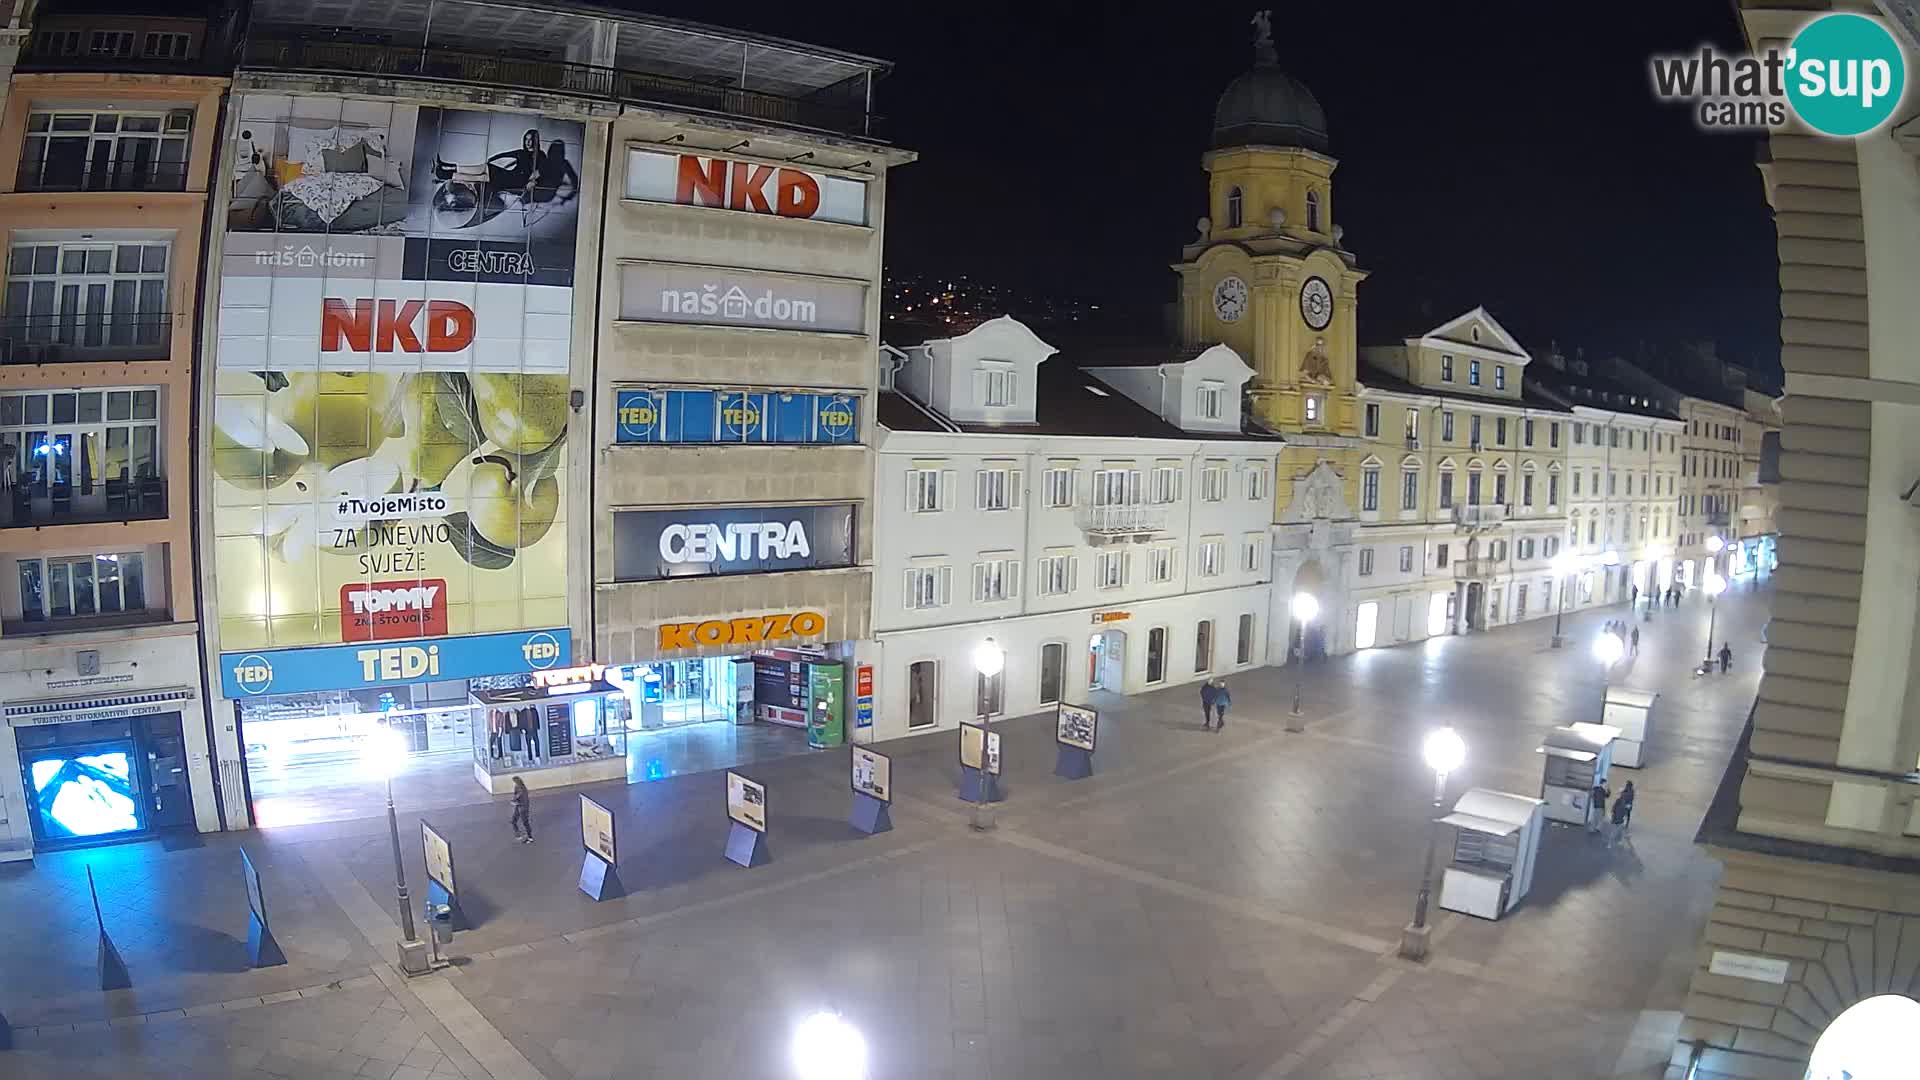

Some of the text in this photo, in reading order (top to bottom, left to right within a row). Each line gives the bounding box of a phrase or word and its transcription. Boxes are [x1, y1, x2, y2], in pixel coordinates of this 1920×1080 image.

[677, 154, 821, 219] NKD
[255, 246, 366, 268] naš dom
[449, 250, 535, 275] CENTRA
[661, 284, 816, 322] naš dom
[320, 296, 477, 353] NKD
[619, 408, 657, 425] TEDi
[723, 409, 760, 425] TEDi
[820, 411, 853, 427] TEDi
[338, 497, 446, 516] #TvojeMisto
[333, 523, 450, 548] ZA DNEVNO
[659, 520, 810, 563] CENTRA
[360, 546, 426, 575] SVJEŽE
[348, 586, 439, 613] TOMMY
[380, 614, 400, 625] ŠTO
[659, 612, 825, 651] KORZO
[357, 645, 440, 683] TEDi
[522, 643, 560, 660] TEDi
[233, 665, 273, 683] TEDi
[132, 705, 162, 716] CENTAR
